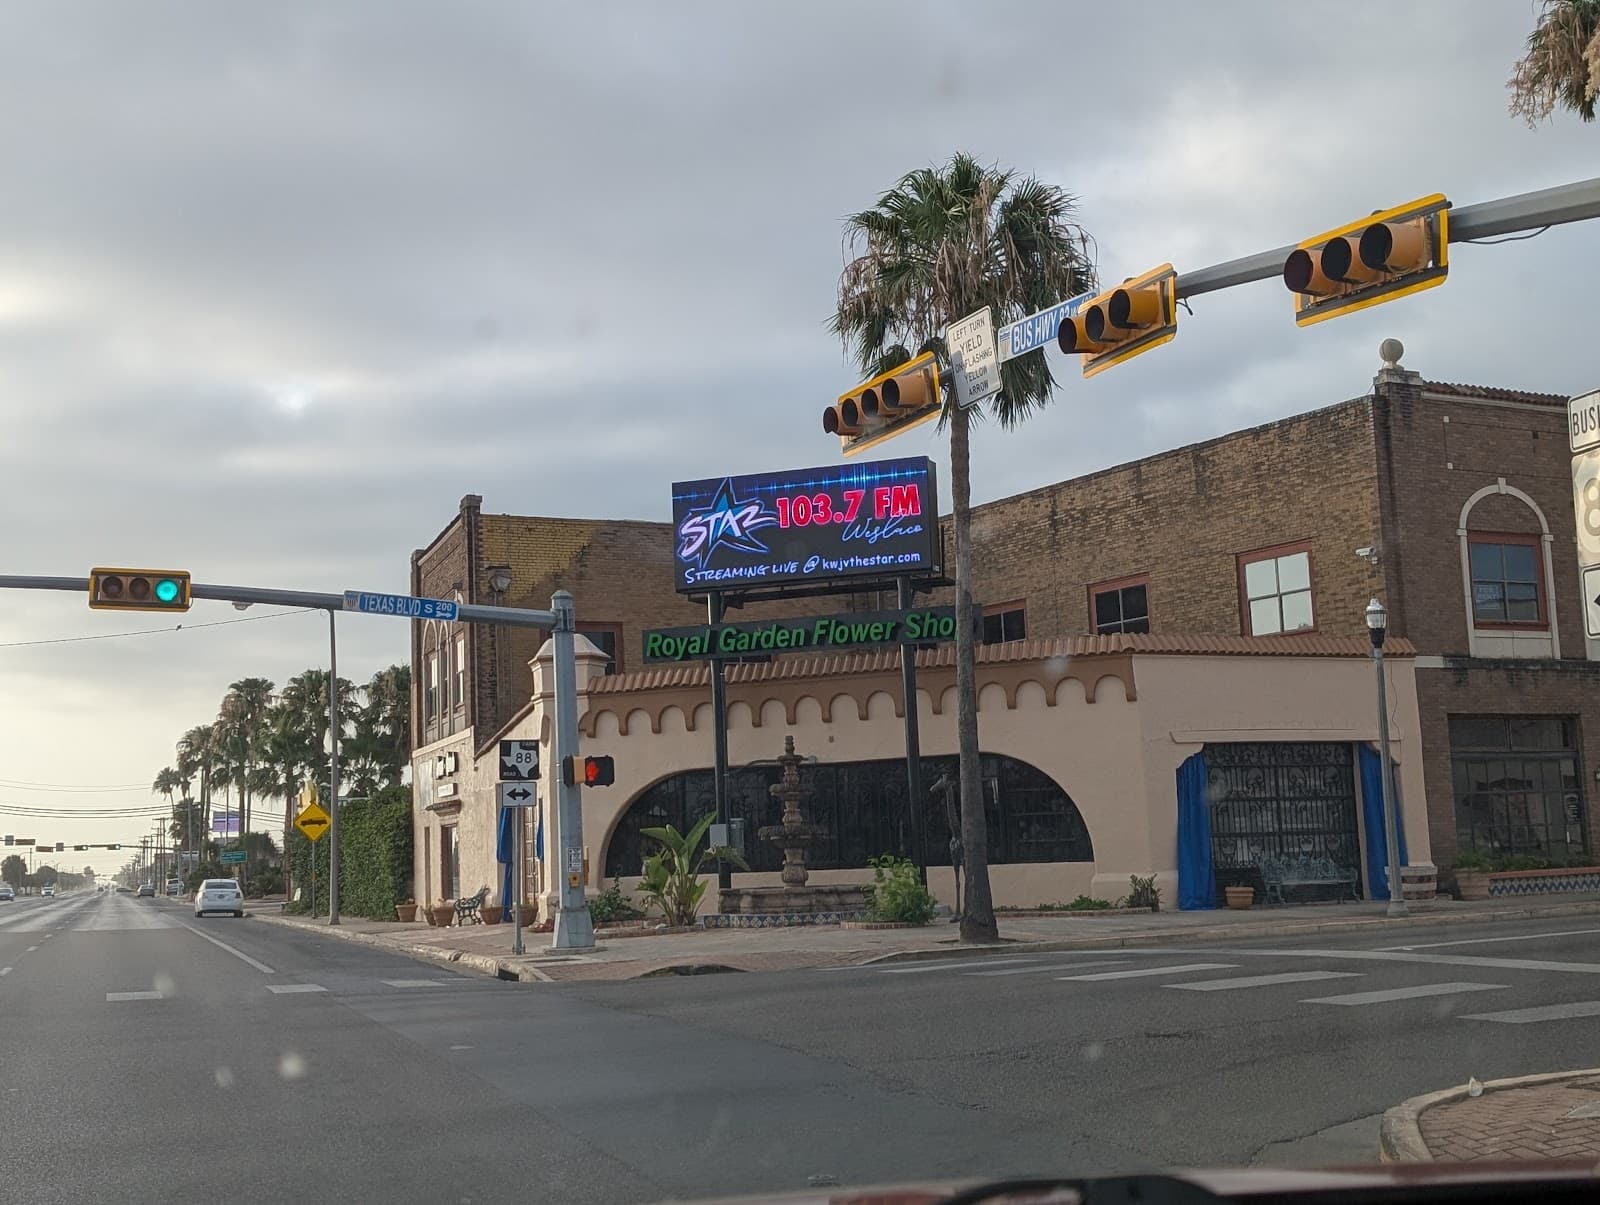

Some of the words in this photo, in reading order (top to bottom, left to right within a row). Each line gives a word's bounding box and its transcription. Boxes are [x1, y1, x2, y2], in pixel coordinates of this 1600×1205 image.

[952, 326, 967, 342] LEFT
[969, 316, 985, 332] TURN
[1013, 320, 1033, 353] BUS
[1035, 309, 1058, 340] HWY
[959, 334, 983, 355] YIELD
[954, 362, 964, 373] ON
[964, 346, 993, 369] FLASHING
[964, 365, 988, 384] YELLOW
[968, 380, 989, 398] ARROW
[776, 489, 866, 529] 103.7
[873, 484, 921, 518] FM
[803, 555, 820, 574] @
[822, 552, 921, 571] kwjvthestar.com
[363, 594, 395, 614] TEXAS
[396, 597, 421, 616] BLVD
[424, 603, 433, 614] S
[435, 602, 453, 612] 200
[646, 631, 711, 660] Royal
[718, 624, 805, 652] Garden
[812, 618, 896, 646] Flower
[904, 612, 956, 640] Sho
[515, 752, 532, 764] 88
